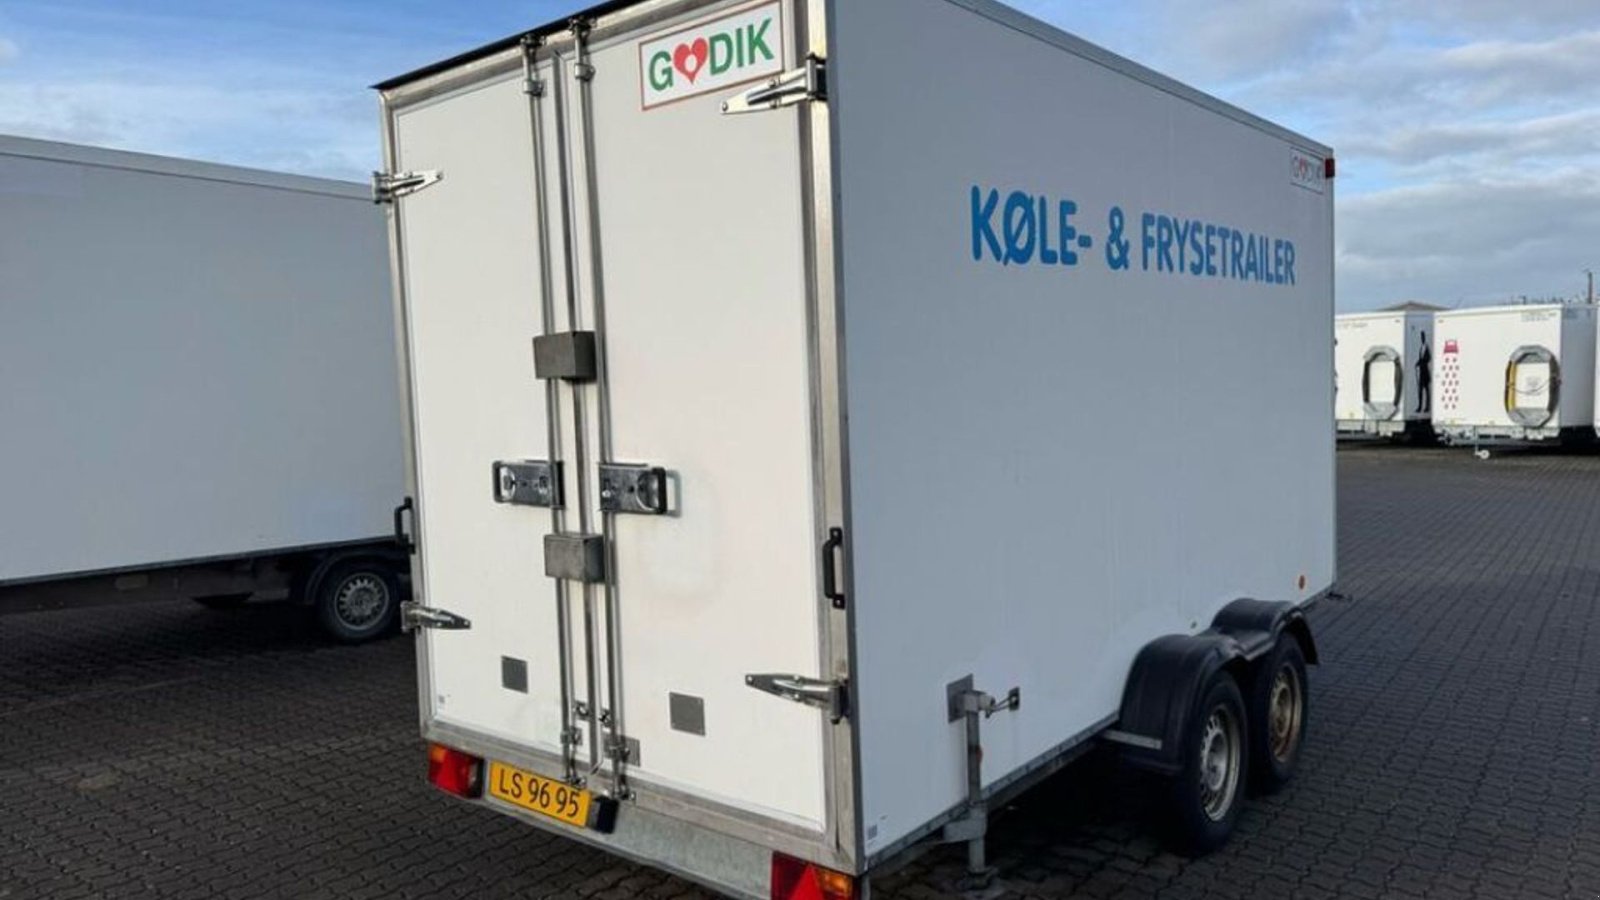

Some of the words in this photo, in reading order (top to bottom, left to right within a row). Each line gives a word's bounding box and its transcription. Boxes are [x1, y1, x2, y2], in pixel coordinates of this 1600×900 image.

[971, 185, 1092, 265] KØLE-
[1106, 206, 1129, 270] &
[1142, 212, 1295, 285] FRYSETRAILER
[500, 769, 523, 799] LS
[528, 778, 550, 809] 96
[555, 786, 579, 818] 95
